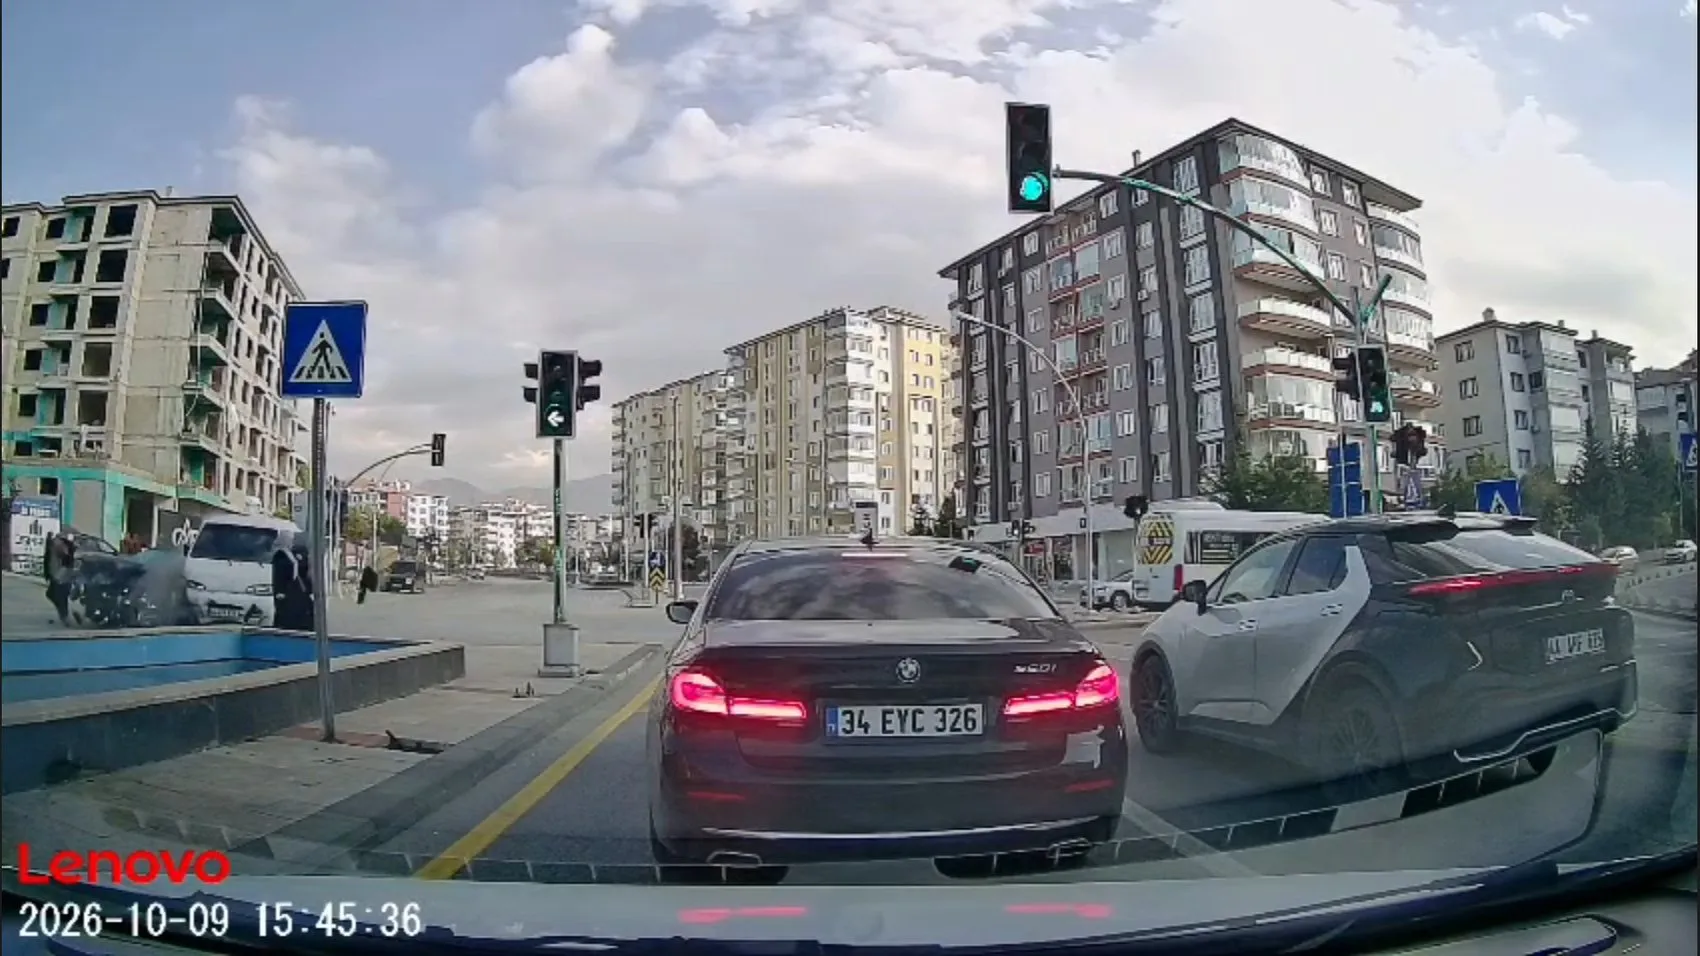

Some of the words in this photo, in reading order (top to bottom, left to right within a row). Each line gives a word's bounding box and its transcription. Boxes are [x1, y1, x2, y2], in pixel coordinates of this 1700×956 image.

[841, 709, 870, 734] 34
[881, 708, 925, 734] EYC
[934, 707, 976, 733] 326
